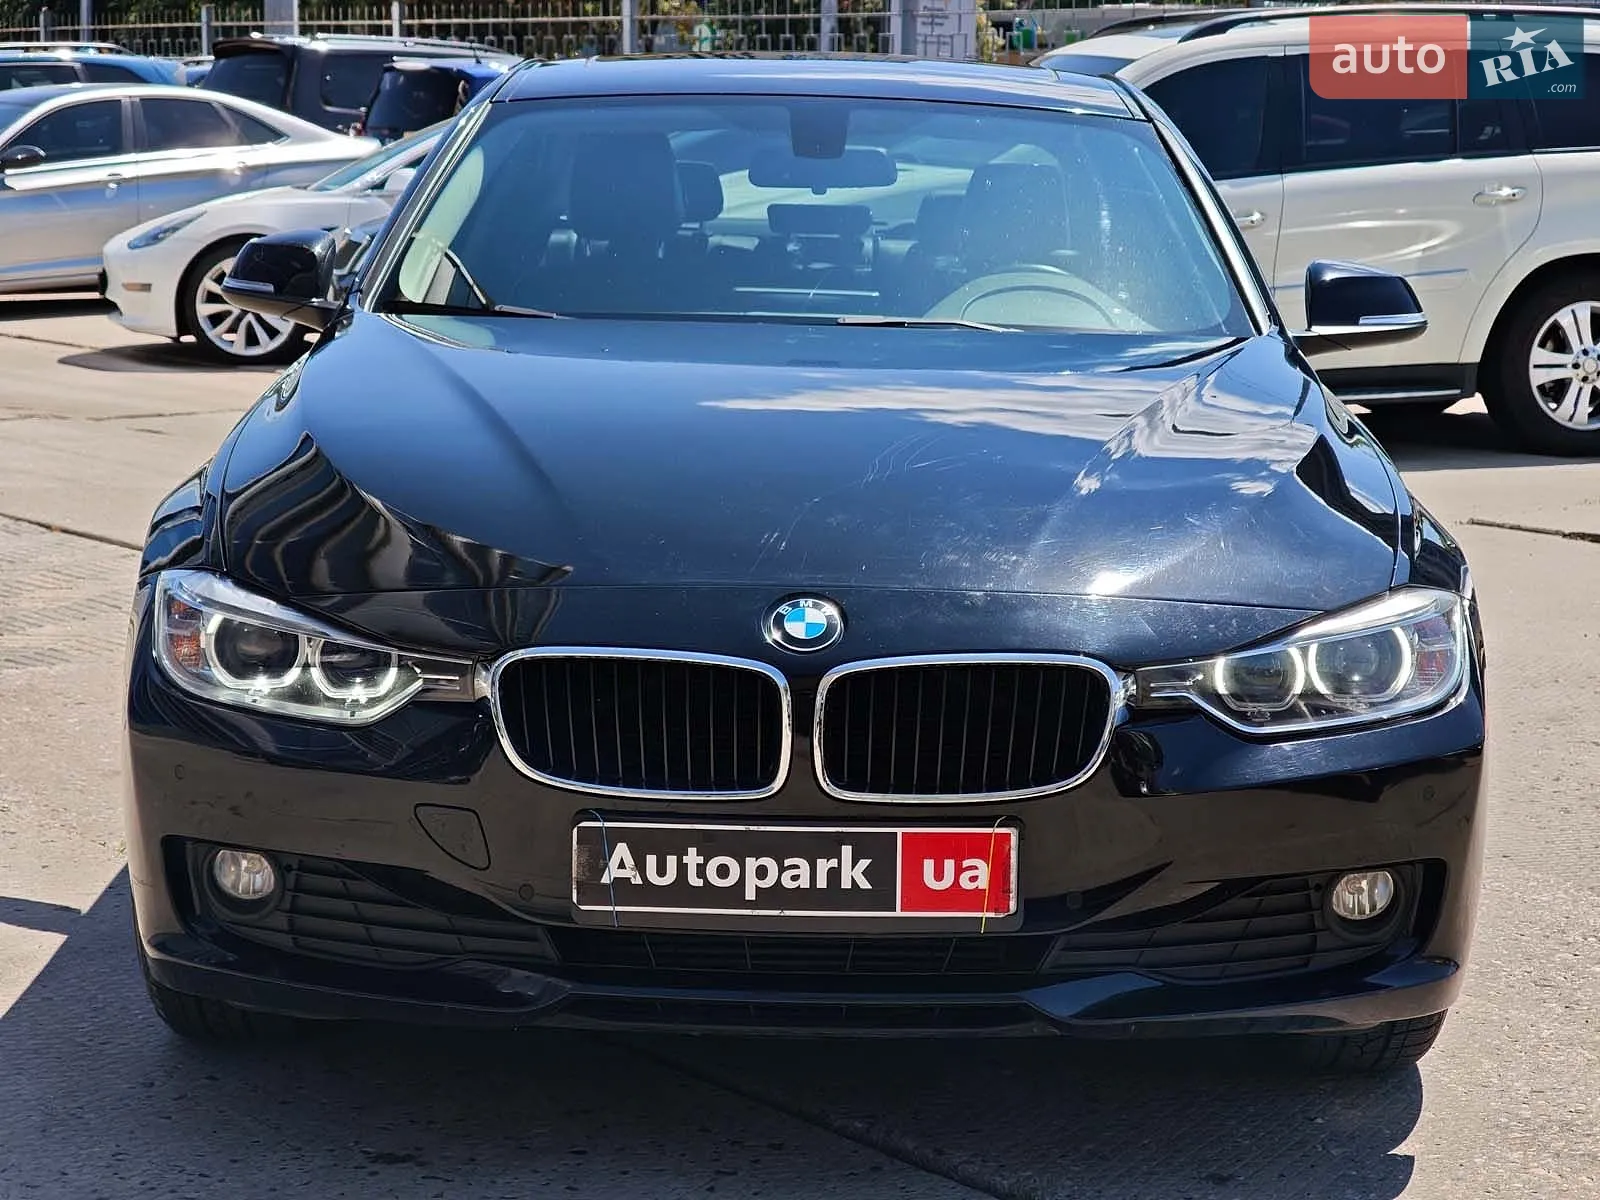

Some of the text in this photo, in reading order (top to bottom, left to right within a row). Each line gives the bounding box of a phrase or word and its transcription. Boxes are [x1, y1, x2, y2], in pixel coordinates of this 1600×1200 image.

[779, 600, 836, 616] BMW
[601, 843, 990, 900] Autopark ua
